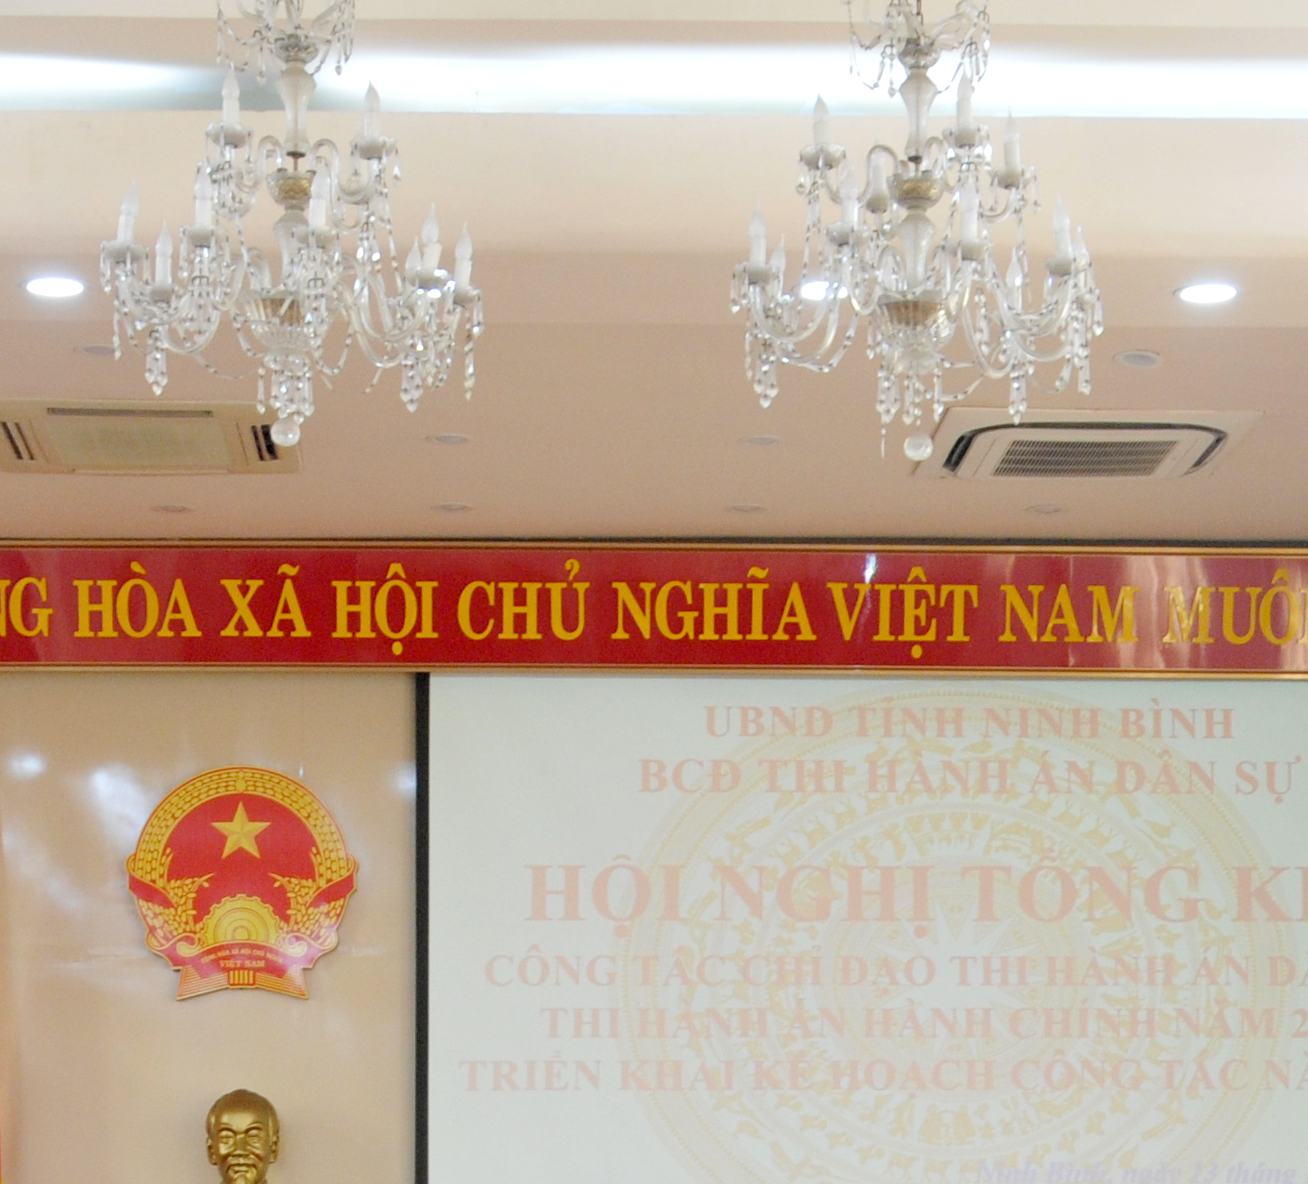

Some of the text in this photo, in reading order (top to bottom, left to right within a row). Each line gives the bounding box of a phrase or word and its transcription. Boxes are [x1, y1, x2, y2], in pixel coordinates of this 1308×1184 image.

[73, 563, 202, 639] HÒA
[221, 565, 312, 638] XÃ
[332, 563, 439, 656] HỘI
[457, 559, 590, 641] CHỦ
[611, 566, 816, 642] NGHĨA
[826, 567, 979, 659] VIỆT
[999, 585, 1141, 644] NAM
[703, 705, 834, 738] UBND
[983, 706, 1101, 739] NINH
[1119, 698, 1235, 740] BÌNH
[638, 758, 742, 793] BCĐ
[758, 758, 848, 794] THI
[1028, 750, 1096, 795] ÁN
[1115, 748, 1218, 795] DÂN
[1235, 755, 1303, 804] SỰ
[524, 854, 686, 939] HỘI
[713, 863, 936, 939] NGHỊ
[960, 848, 1205, 923] TỔNG
[484, 944, 619, 987] CÔNG
[949, 955, 1029, 987] THI
[540, 1007, 622, 1038] THI
[863, 998, 994, 1039] HÀNH
[1008, 998, 1157, 1039] CHÍNH
[618, 1059, 735, 1091] KHAI
[830, 1059, 996, 1099] HOẠCH
[1009, 1049, 1145, 1092] CÔNG
